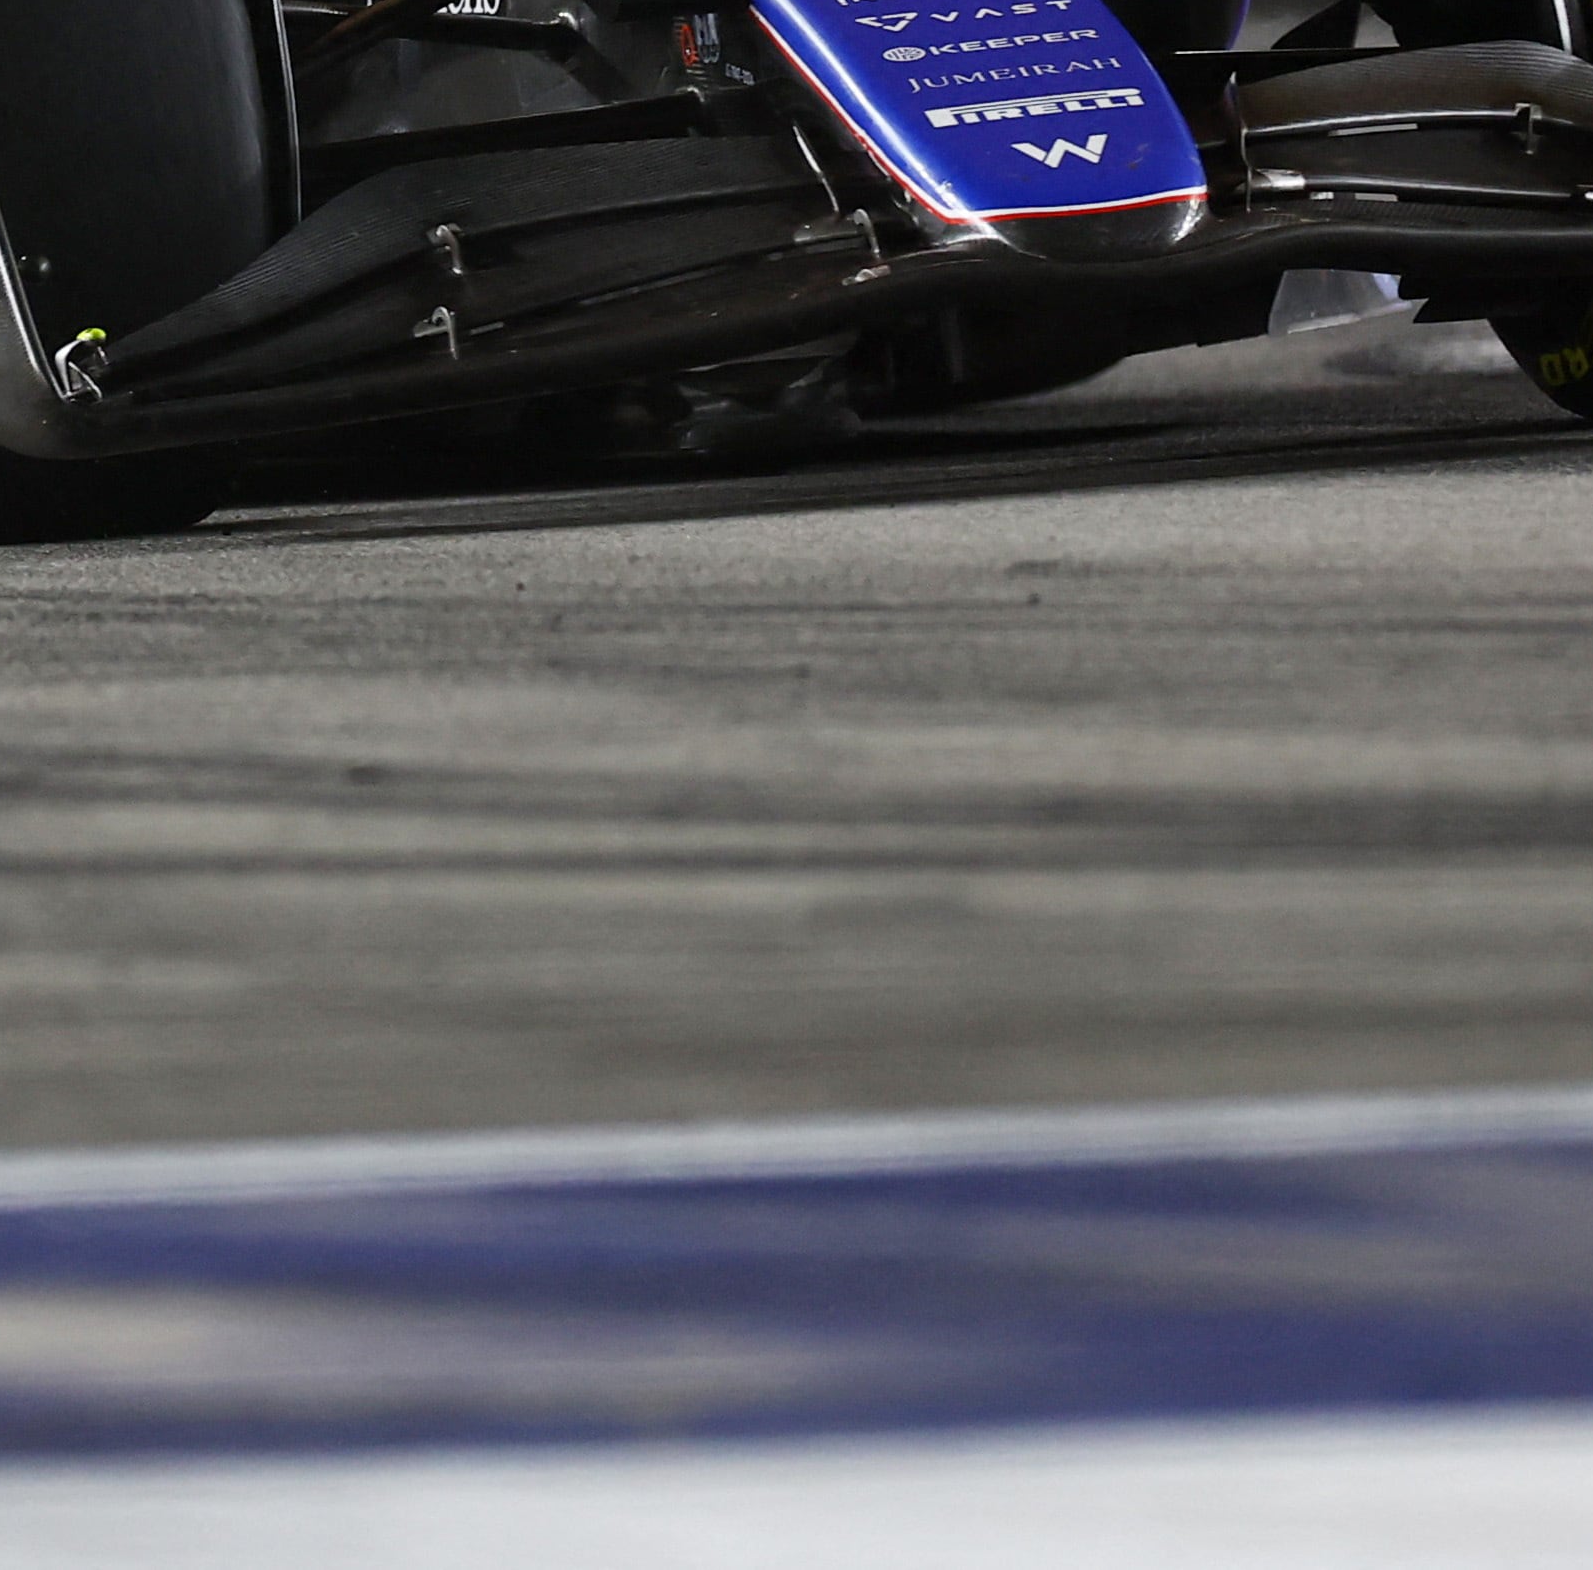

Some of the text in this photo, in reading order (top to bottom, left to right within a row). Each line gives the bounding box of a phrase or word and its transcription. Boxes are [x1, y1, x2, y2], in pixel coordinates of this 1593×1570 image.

[929, 0, 1073, 23] VAST
[928, 29, 1100, 56] KEEPER
[908, 57, 1123, 94] JUMEIRAH
[923, 87, 1145, 129] PIRELLI
